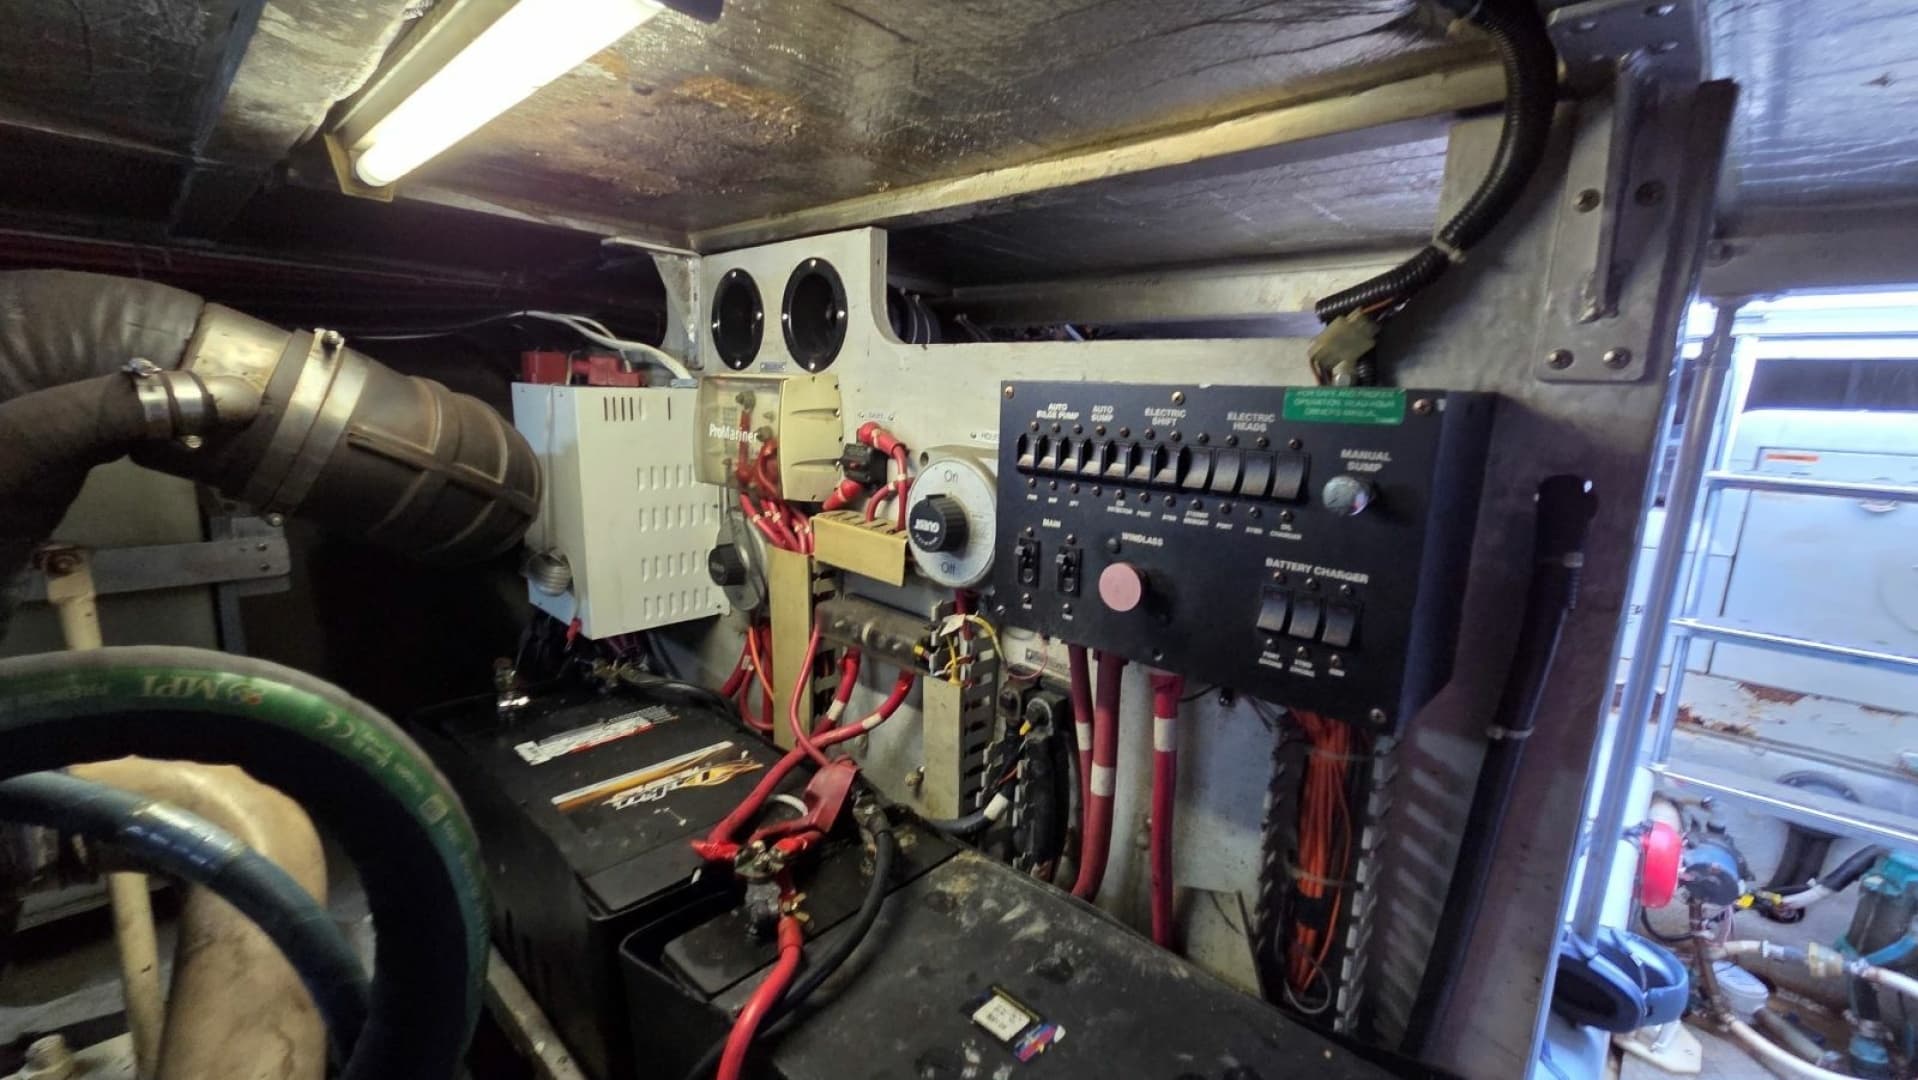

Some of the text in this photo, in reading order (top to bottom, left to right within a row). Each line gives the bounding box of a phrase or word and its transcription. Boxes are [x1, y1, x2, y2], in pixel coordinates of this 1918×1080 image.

[1048, 403, 1068, 411] AUTO
[1092, 405, 1114, 414] AUTO
[1144, 407, 1186, 419] ELECTRIC
[1058, 411, 1079, 420] PUMP
[1091, 413, 1114, 422] SUMP
[1152, 416, 1178, 427] SHIFT
[1226, 411, 1276, 423] ELECTRIC
[709, 423, 759, 443] ProMariner
[1233, 421, 1268, 433] HEADS
[1340, 449, 1392, 462] MANUAL
[1347, 461, 1383, 472] SUMP
[944, 470, 959, 483] On
[1042, 518, 1061, 528] MAIN
[1121, 532, 1164, 547] WINDLASS
[940, 561, 956, 575] Off
[1265, 557, 1369, 584] BATTERY CHARGER
